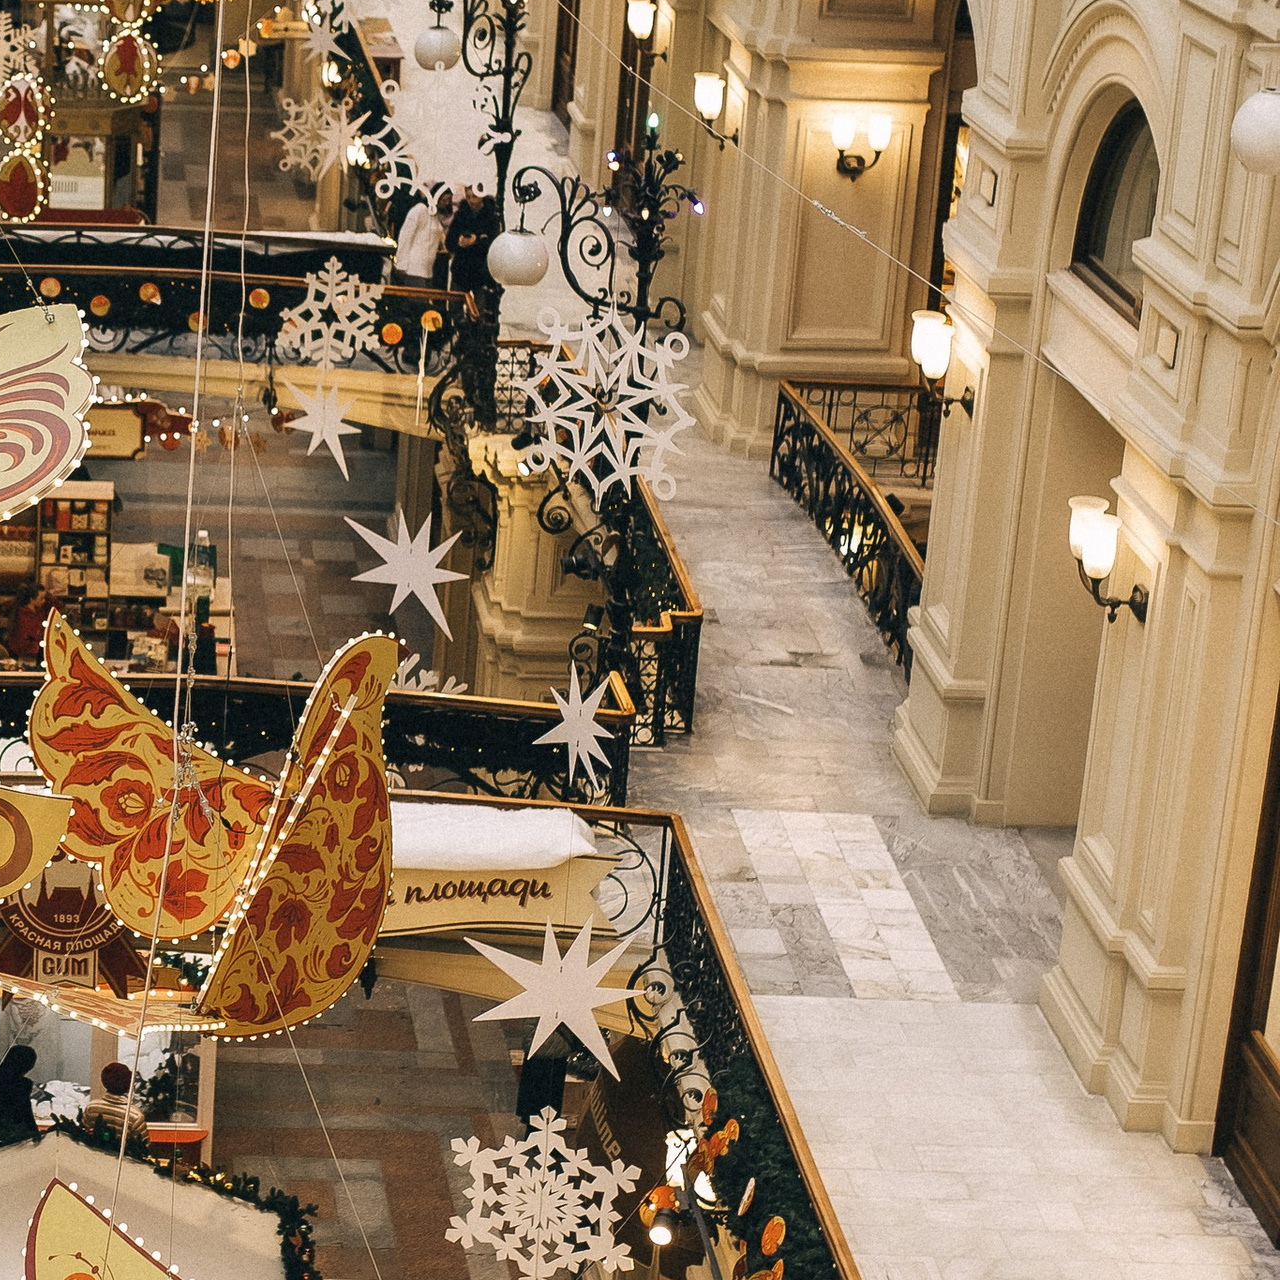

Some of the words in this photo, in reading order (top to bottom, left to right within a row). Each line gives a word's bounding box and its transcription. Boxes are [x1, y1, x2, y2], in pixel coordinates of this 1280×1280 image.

[404, 877, 552, 907] площади
[53, 913, 80, 924] 1893
[9, 913, 62, 951] КРАСНАЯ
[64, 918, 123, 952] ПЛОЩАД
[42, 957, 90, 976] GUM
